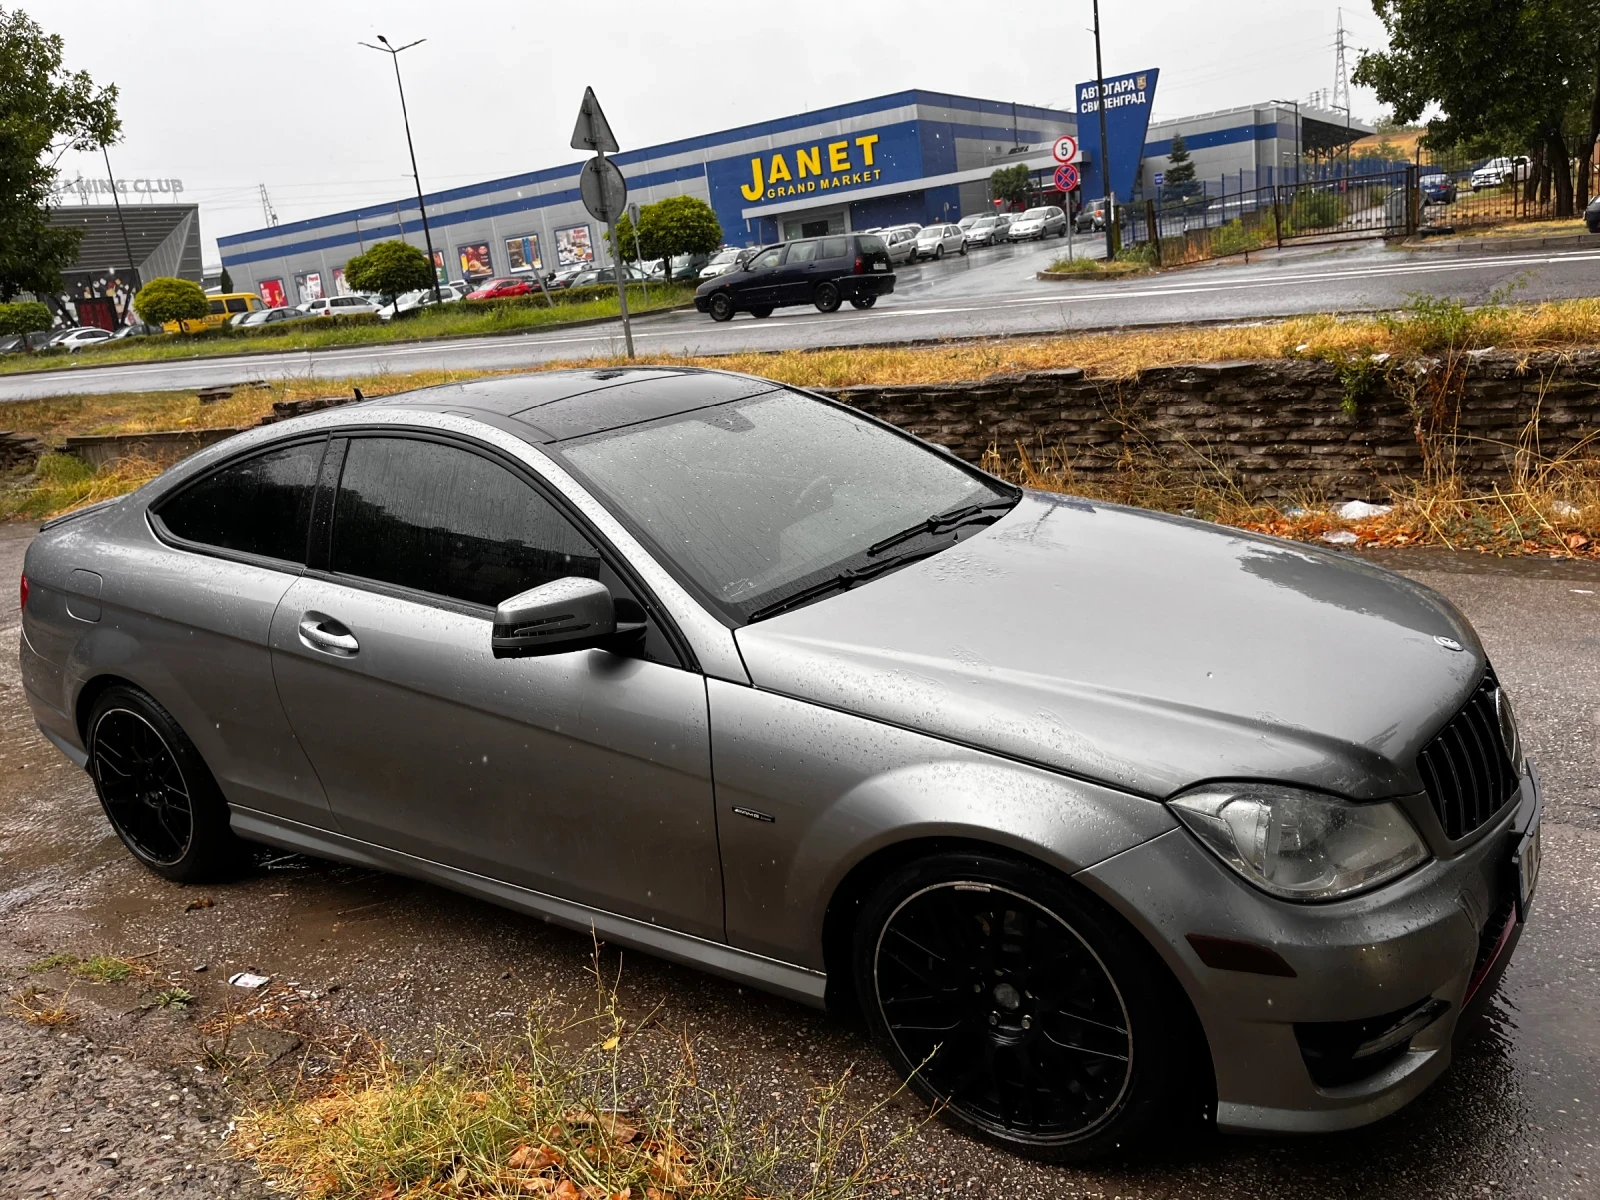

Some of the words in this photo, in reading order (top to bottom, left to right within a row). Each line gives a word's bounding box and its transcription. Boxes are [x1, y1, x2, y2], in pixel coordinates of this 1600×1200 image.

[1081, 79, 1135, 100] АВТОГАРА
[1061, 142, 1068, 156] 5
[741, 134, 879, 201] JANET
[133, 179, 184, 194] CLUB
[767, 181, 816, 199] GRAND
[820, 169, 881, 190] MARKET
